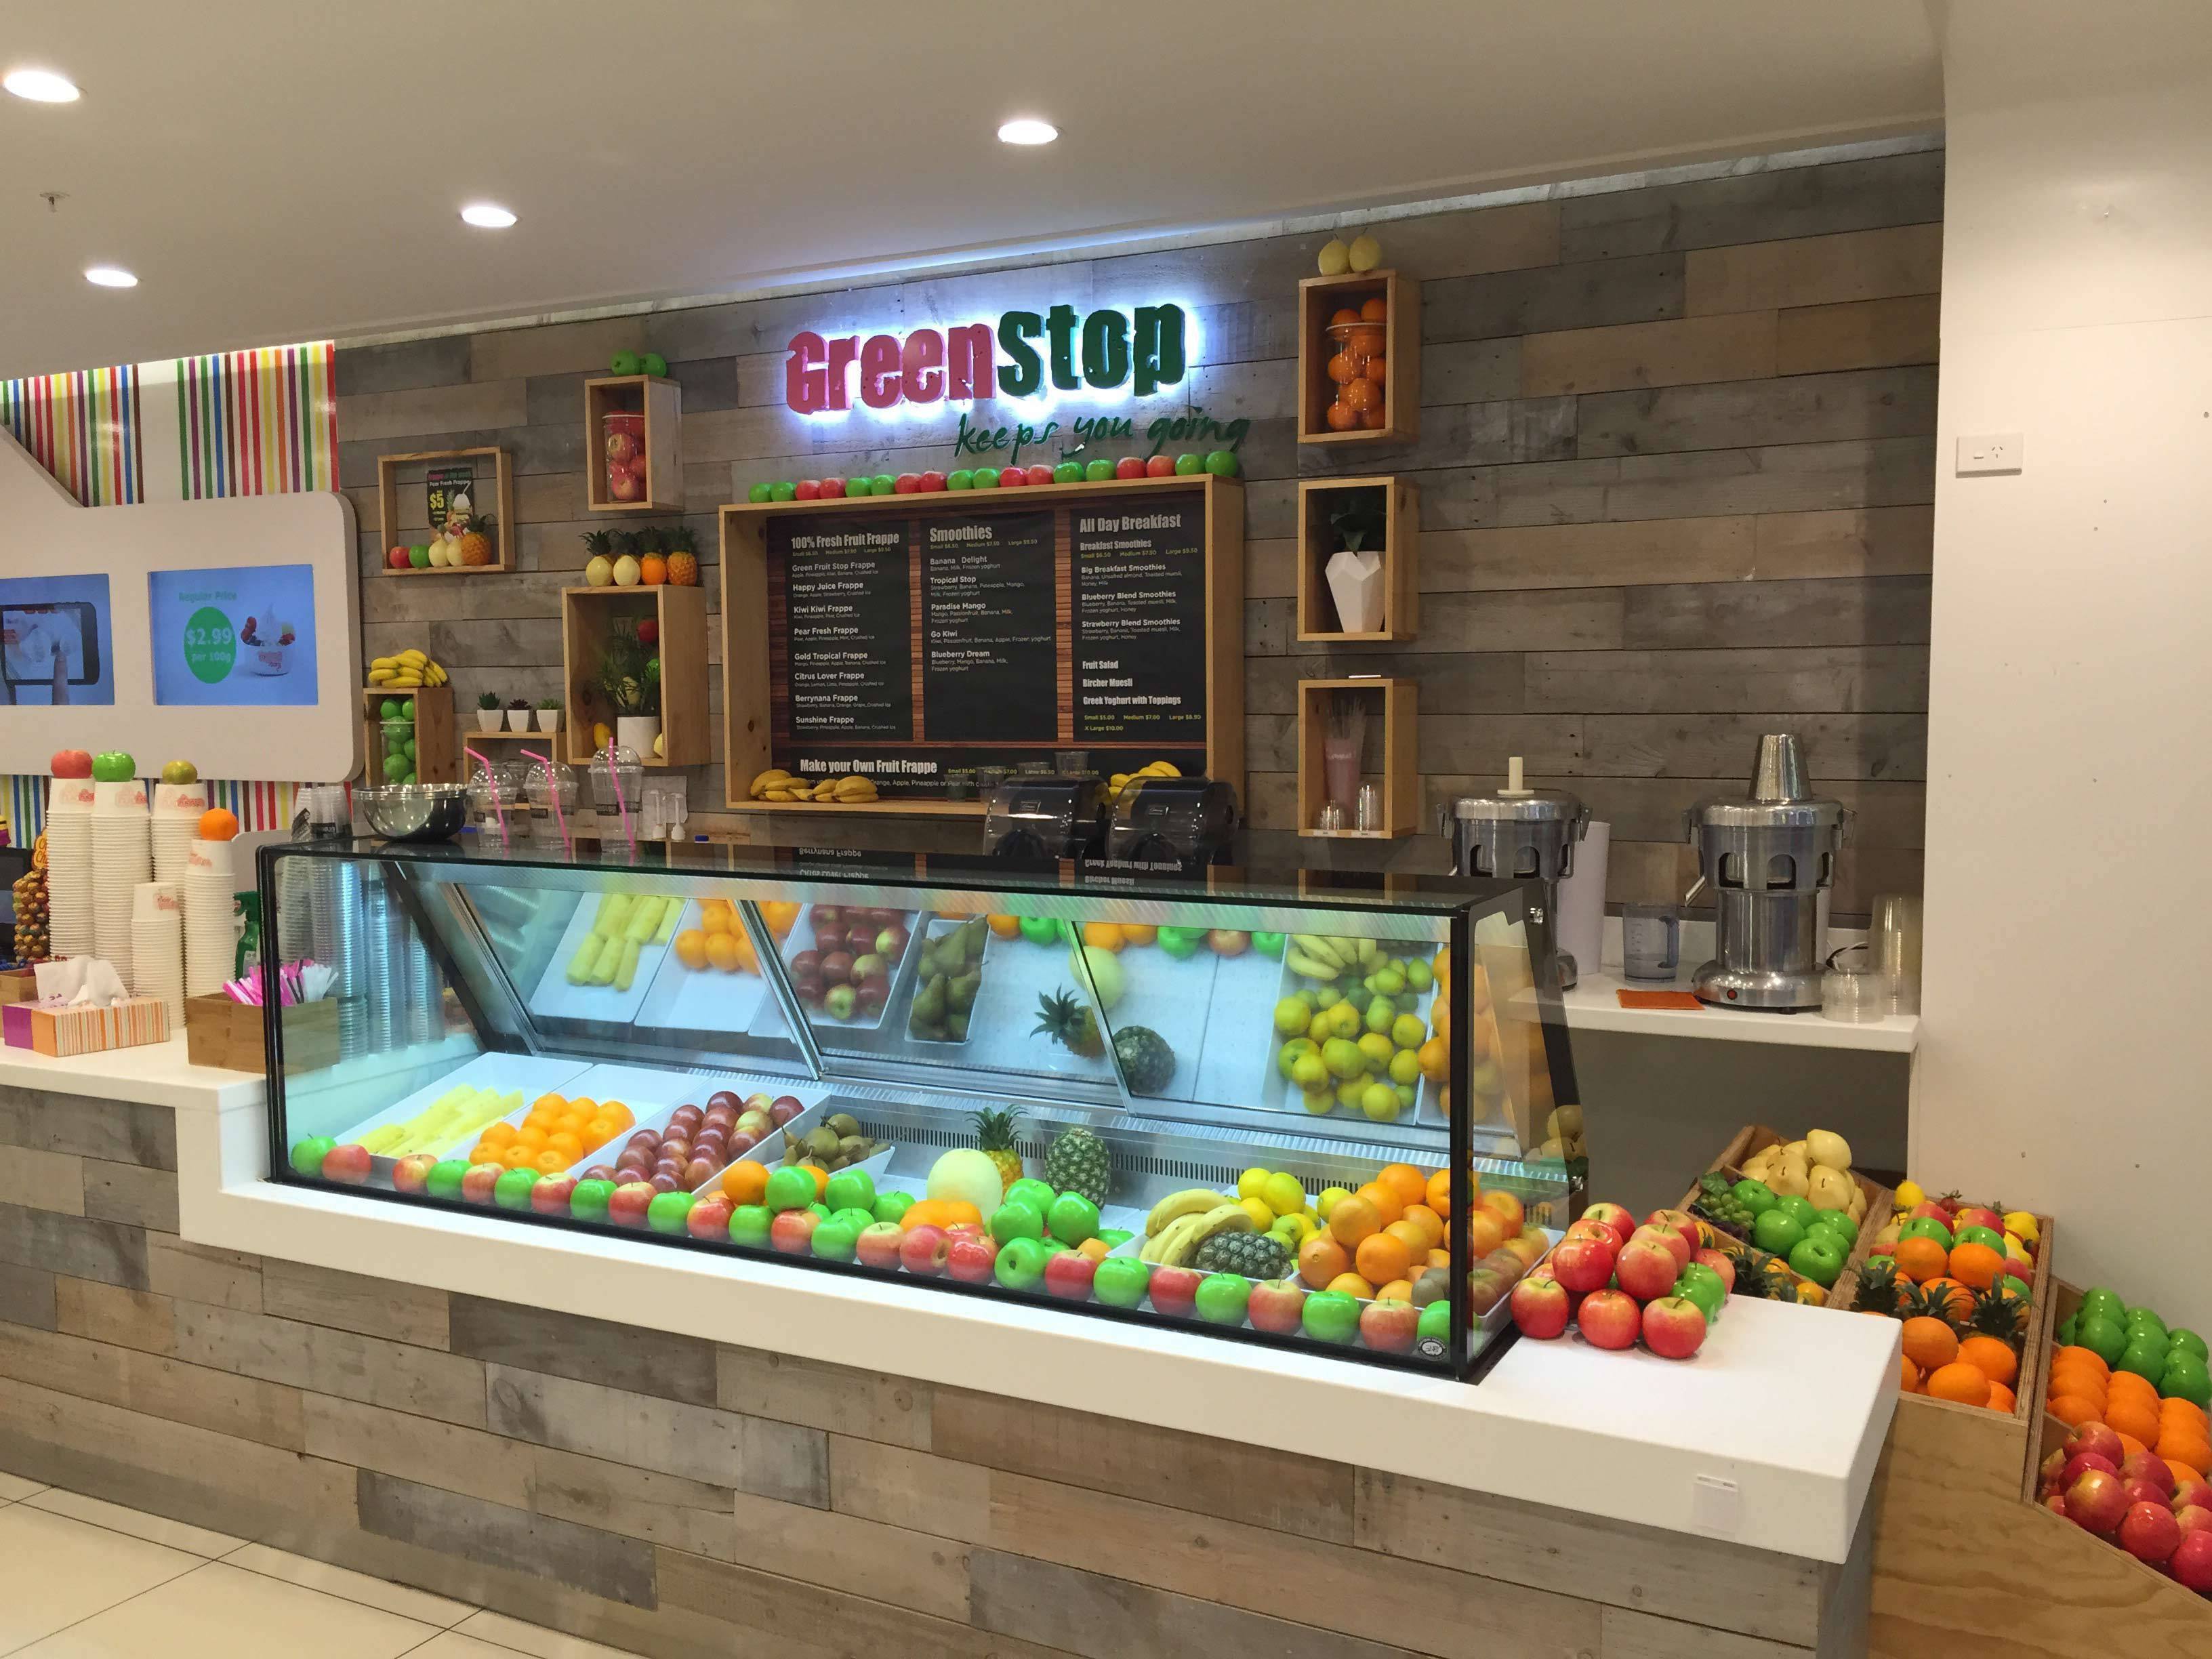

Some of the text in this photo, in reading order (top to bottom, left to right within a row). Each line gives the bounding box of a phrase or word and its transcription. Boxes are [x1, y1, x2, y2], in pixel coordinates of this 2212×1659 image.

[955, 406, 1250, 466] keeps you going
[430, 493, 445, 510] $5
[1080, 514, 1181, 533] All Day Breakfast
[930, 525, 992, 541] Smoothies
[792, 533, 899, 549] 100% Fresh Fruit Frappe
[1080, 539, 1151, 551] Breakfast Smoothies
[179, 591, 237, 602] Regular Price
[186, 628, 232, 647] $2.99
[191, 652, 230, 663] per 100g
[1083, 661, 1118, 669] Fruit Salad
[1109, 678, 1132, 687] Muesli
[796, 695, 831, 703] Berrynana
[1084, 696, 1181, 705] Greek Yoghurt with Toppings
[800, 759, 937, 774] Make your Own Fruit Frappe
